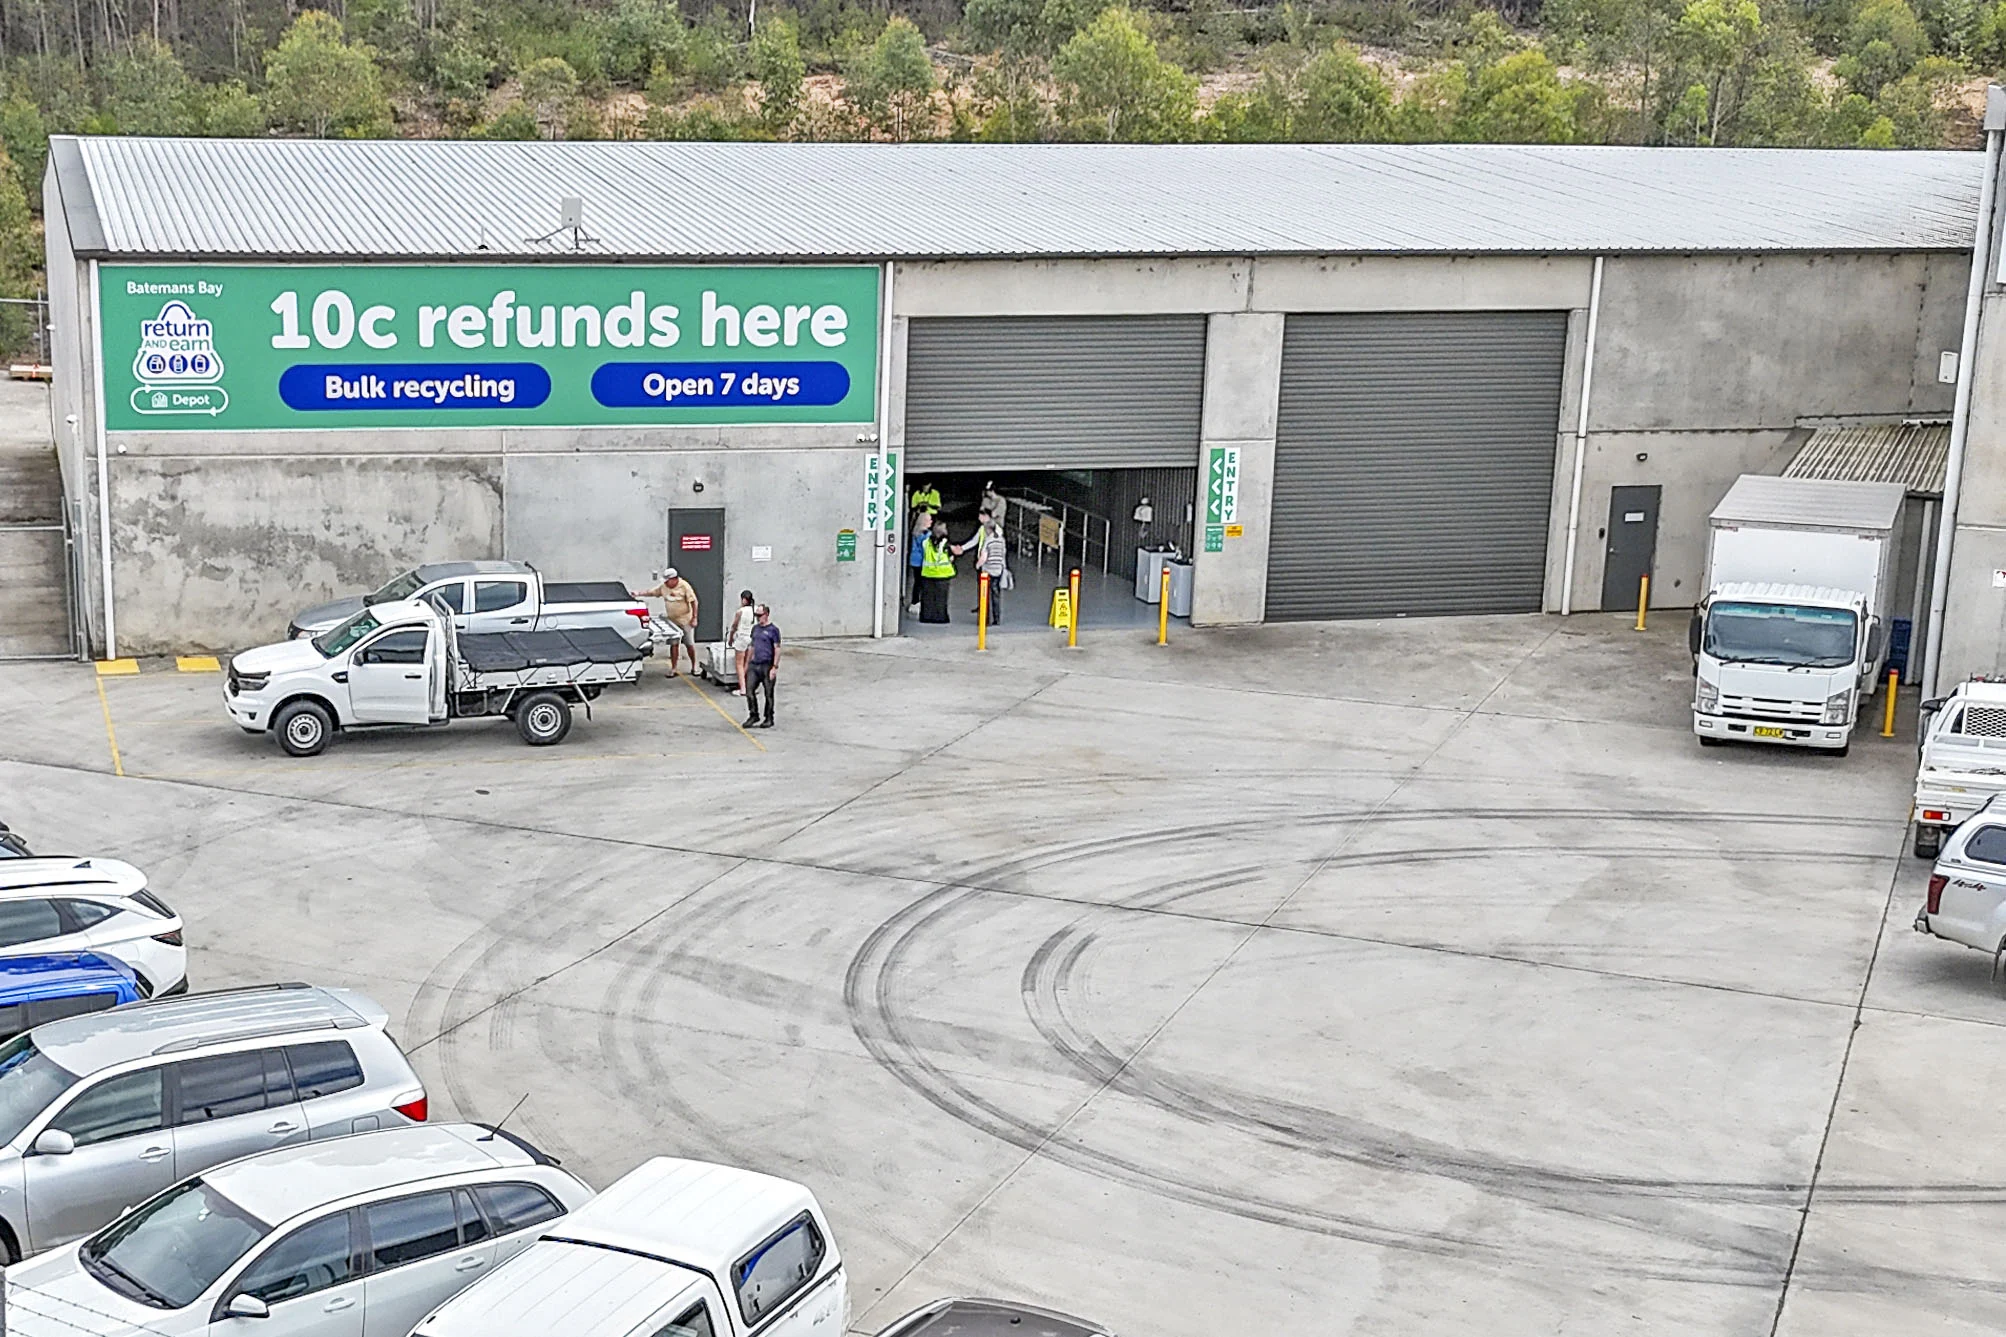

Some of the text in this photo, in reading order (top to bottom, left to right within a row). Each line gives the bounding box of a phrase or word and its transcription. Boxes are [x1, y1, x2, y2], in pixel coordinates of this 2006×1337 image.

[127, 281, 223, 297] Batemans Bay
[144, 320, 209, 337] return
[270, 290, 848, 350] 10c refunds here
[144, 338, 210, 352] AND earn
[172, 393, 210, 407] Depot
[325, 374, 515, 404] Bulk recycling
[643, 372, 800, 401] Open 7 days
[867, 457, 879, 529] ENTRY
[1224, 452, 1236, 521] ENTRY
